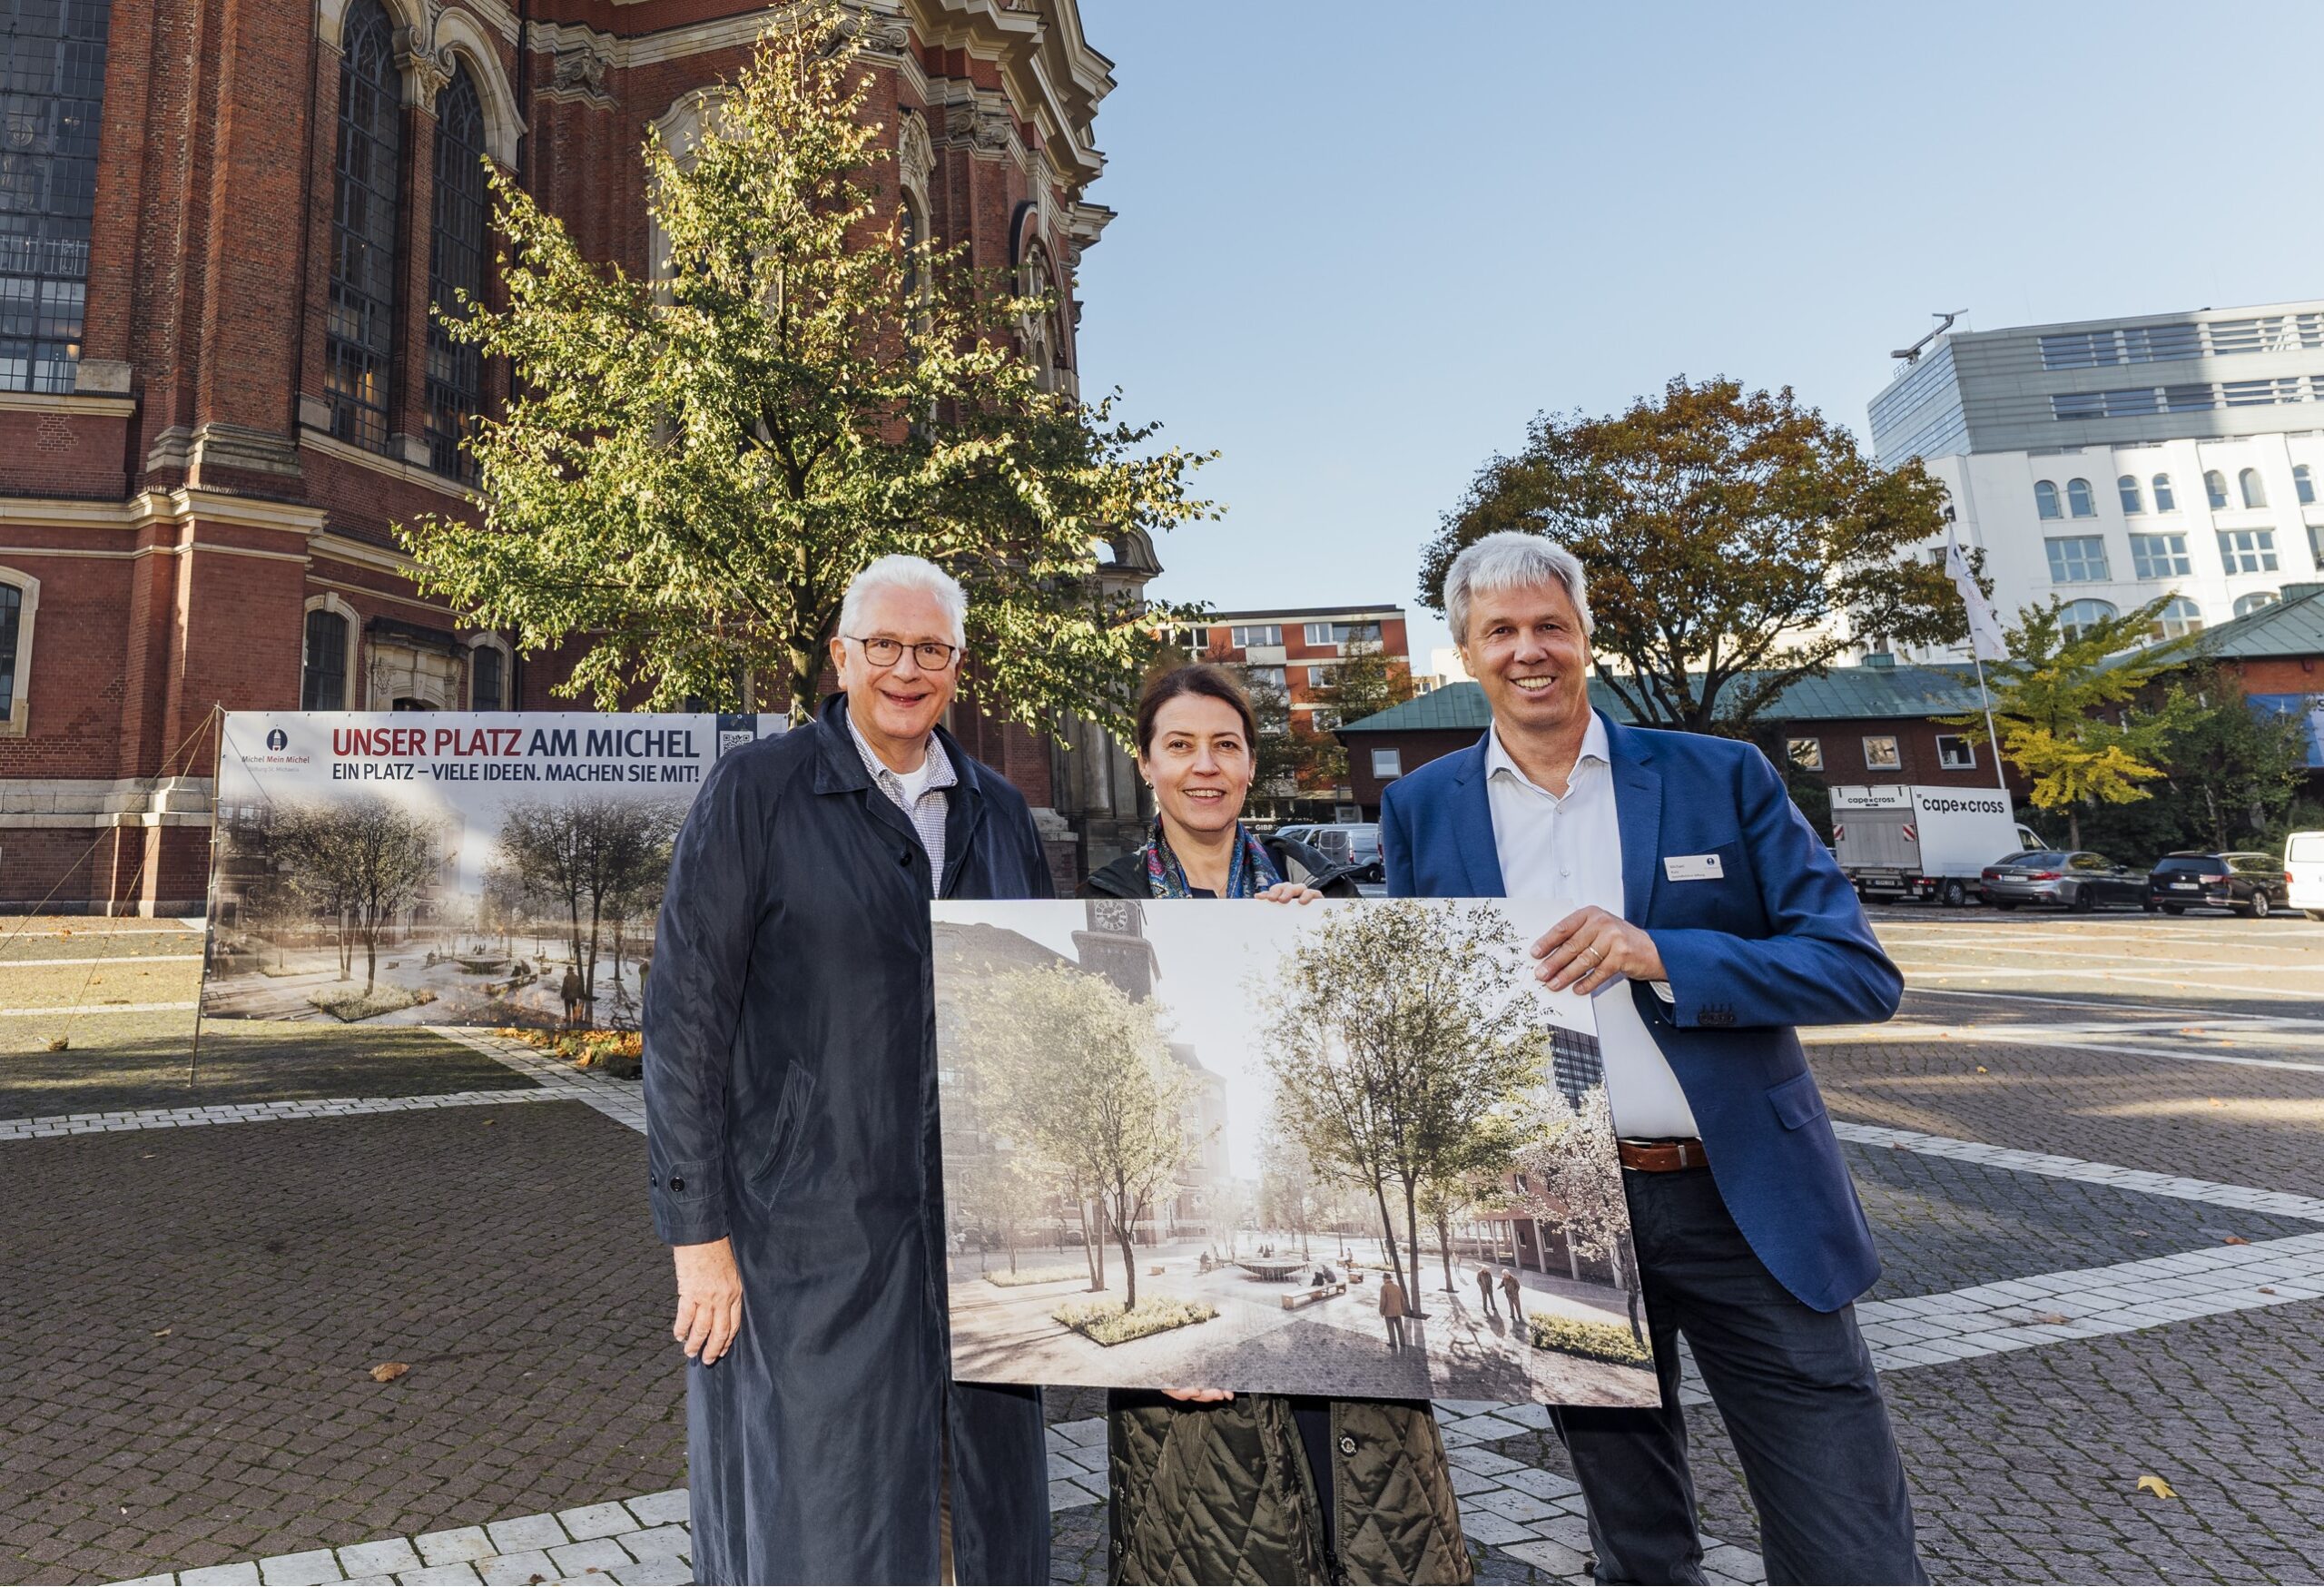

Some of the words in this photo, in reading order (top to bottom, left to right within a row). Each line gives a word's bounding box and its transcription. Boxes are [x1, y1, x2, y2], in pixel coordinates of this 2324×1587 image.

[332, 728, 427, 756] UNSER
[434, 728, 523, 756] PLATZ
[527, 729, 577, 756] AM
[586, 729, 700, 758] MICHEL
[285, 755, 310, 764] Michel
[332, 764, 359, 780] EIN
[364, 764, 414, 780] PLATZ
[431, 764, 479, 781] VIELE
[483, 764, 541, 781] IDEEN.
[545, 764, 624, 782] MACHEN
[627, 764, 657, 782] SIE
[660, 764, 699, 783] MIT!
